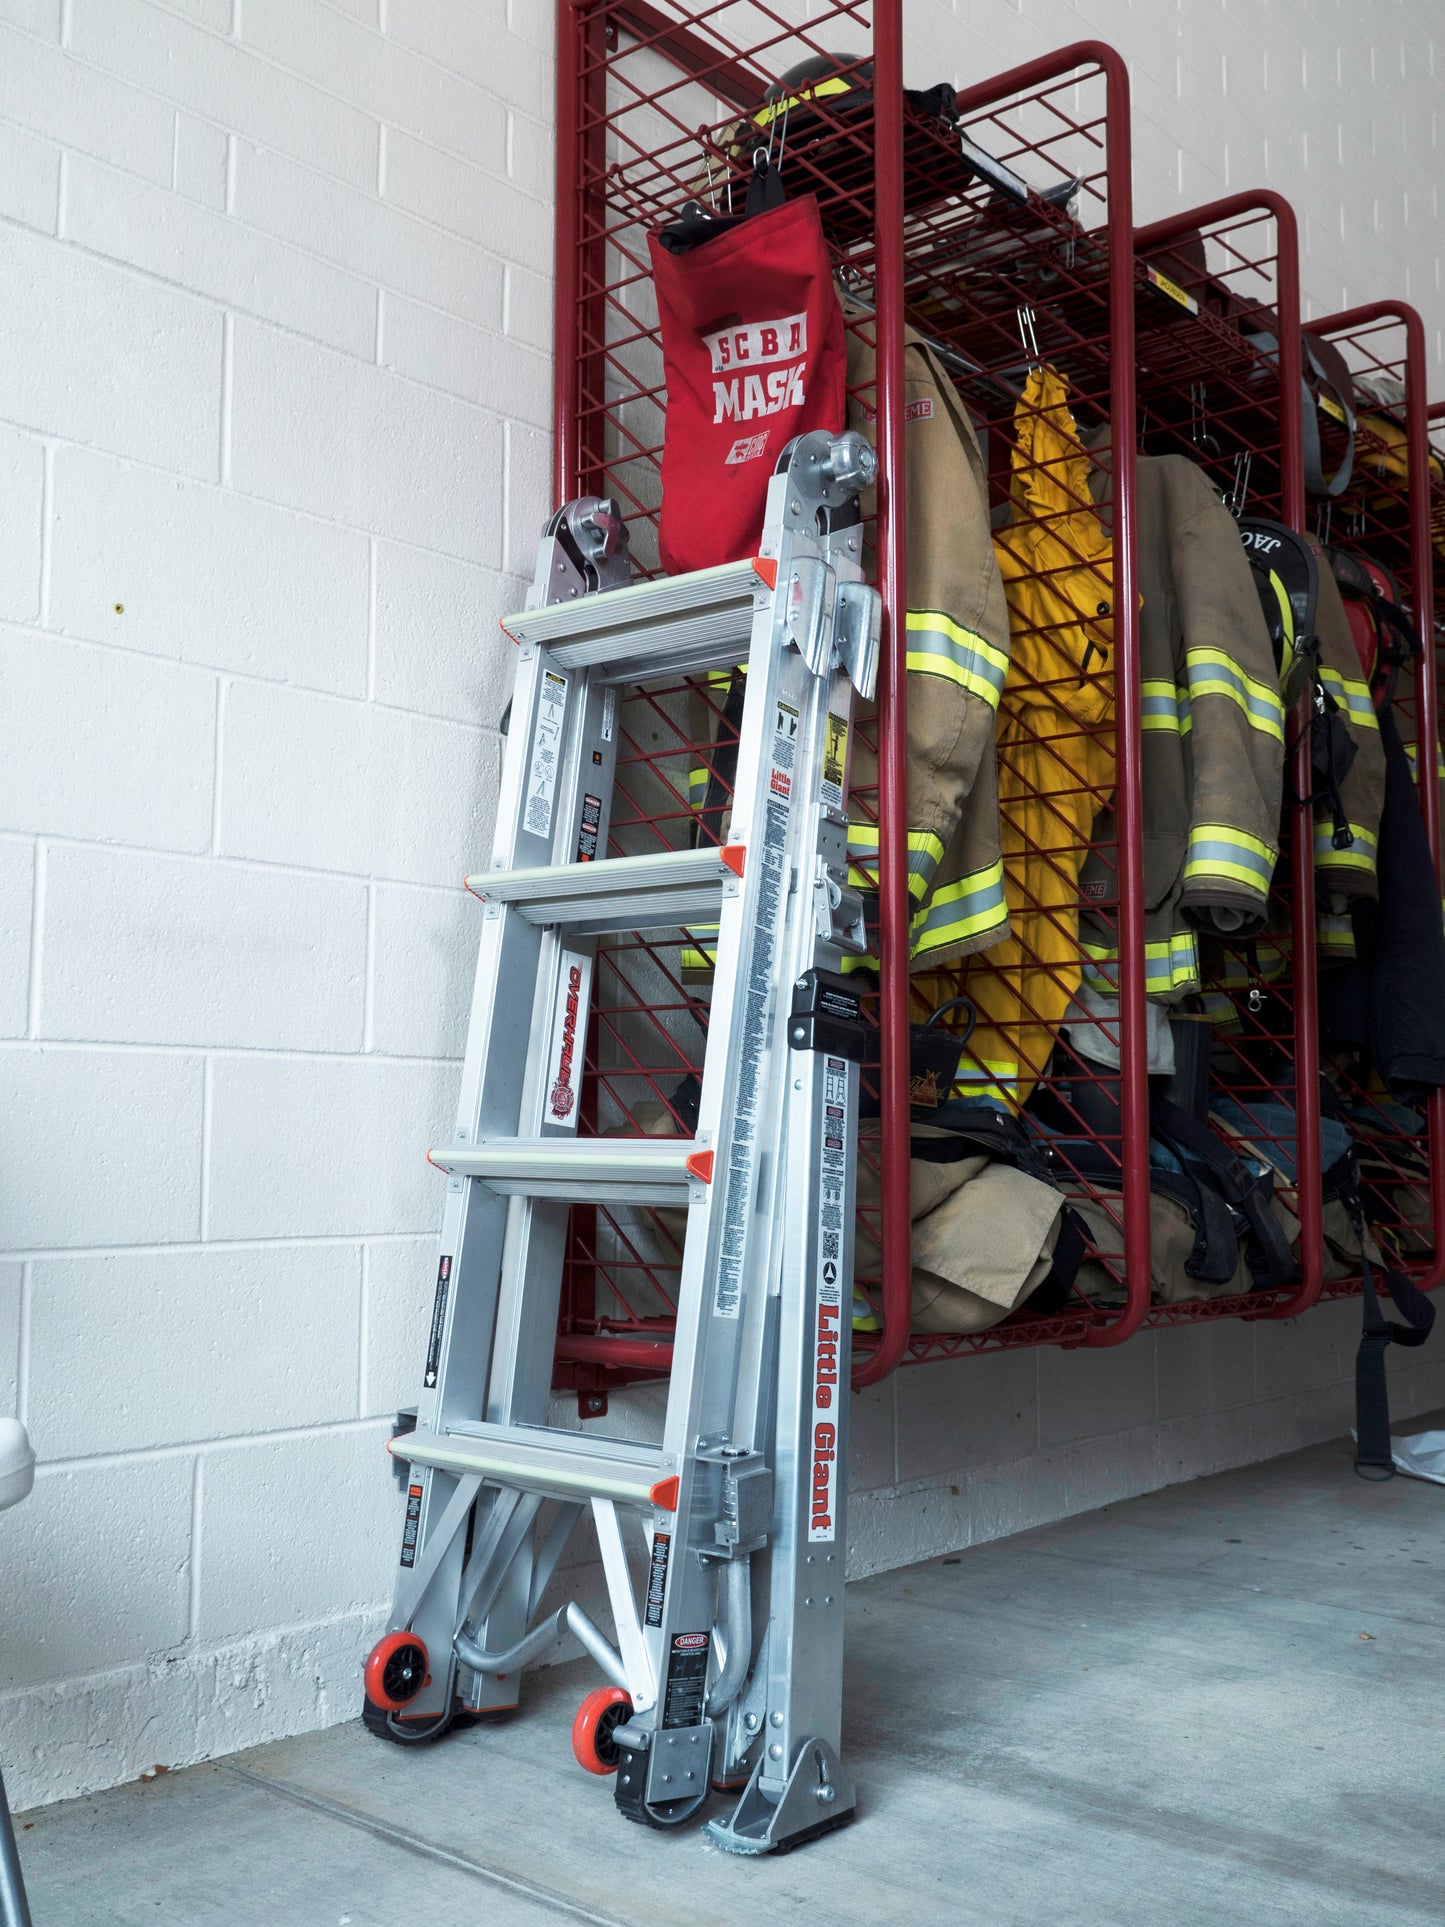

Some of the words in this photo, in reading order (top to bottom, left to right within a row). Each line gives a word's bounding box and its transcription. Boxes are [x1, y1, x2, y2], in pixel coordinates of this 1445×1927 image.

[717, 323, 801, 365] SCBA
[713, 362, 806, 424] MASK
[778, 702, 799, 717] CAUTION
[770, 779, 791, 797] Giant
[771, 768, 791, 786] Little
[558, 965, 582, 1083] OVERHAUL
[815, 1303, 839, 1409] Little
[812, 1422, 836, 1531] Giant
[680, 1636, 705, 1646] DANGER
